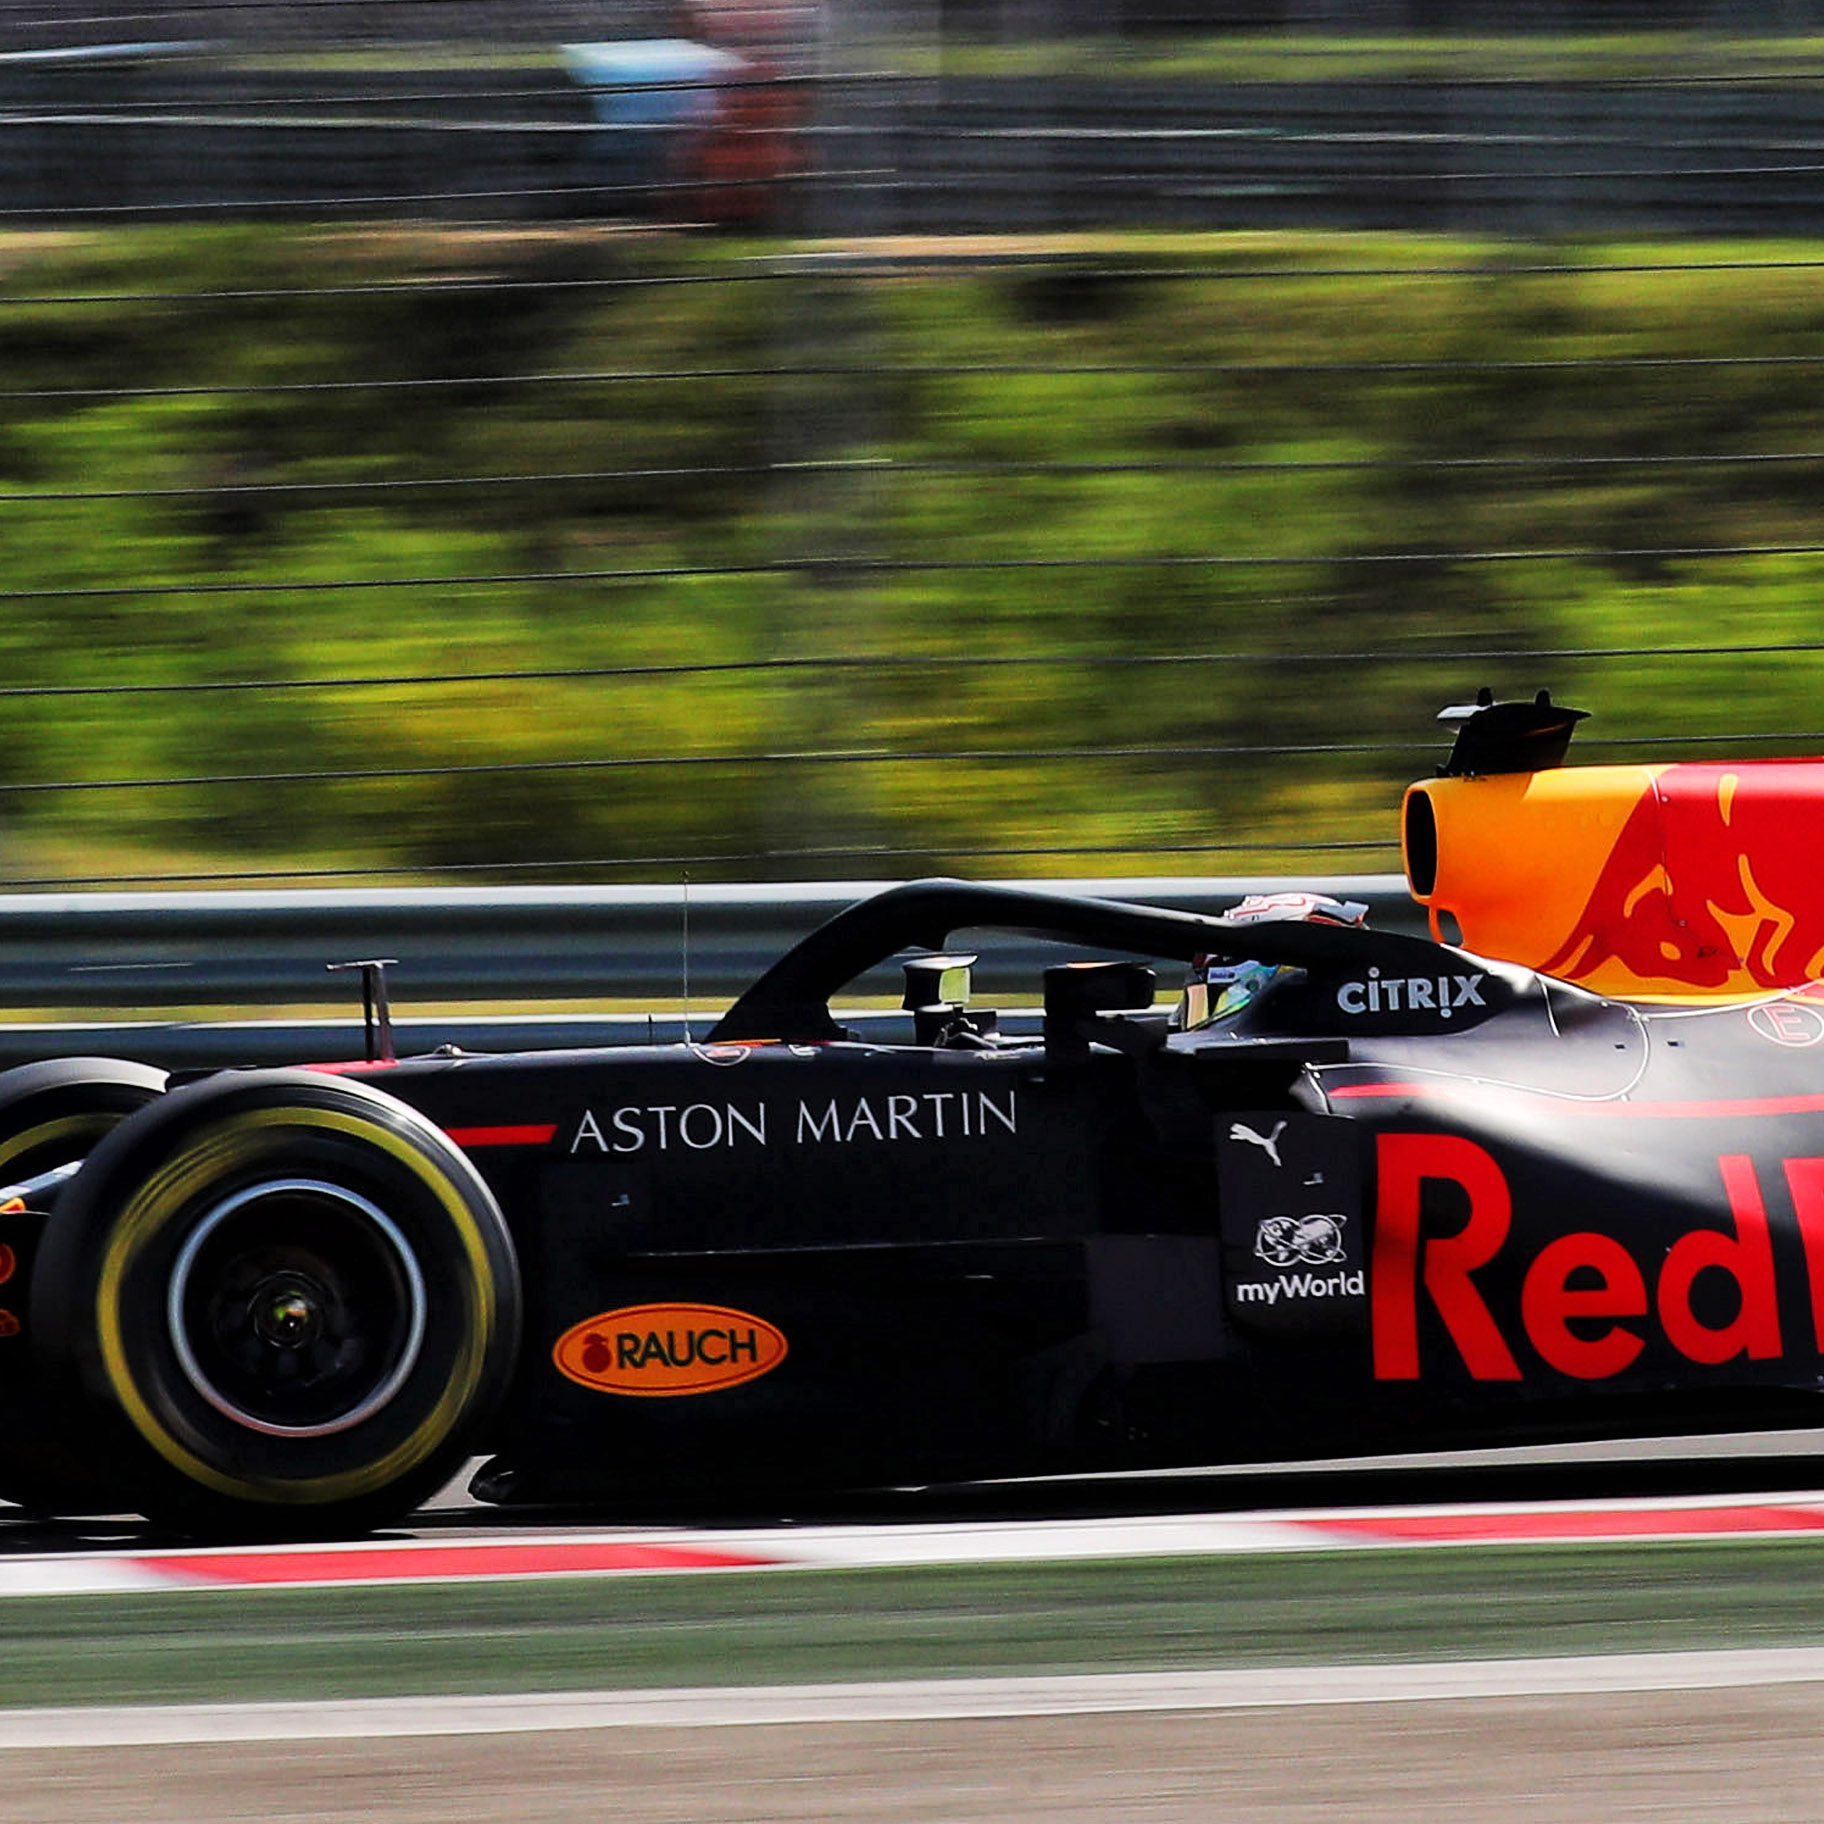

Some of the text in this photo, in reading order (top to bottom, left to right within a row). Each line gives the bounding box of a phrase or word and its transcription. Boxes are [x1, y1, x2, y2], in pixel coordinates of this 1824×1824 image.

[570, 1089, 1017, 1154] ASTON MARTIN
[1371, 1132, 1783, 1380] Red
[1236, 1269, 1366, 1305] myWorld
[616, 1328, 758, 1370] RAUCH
